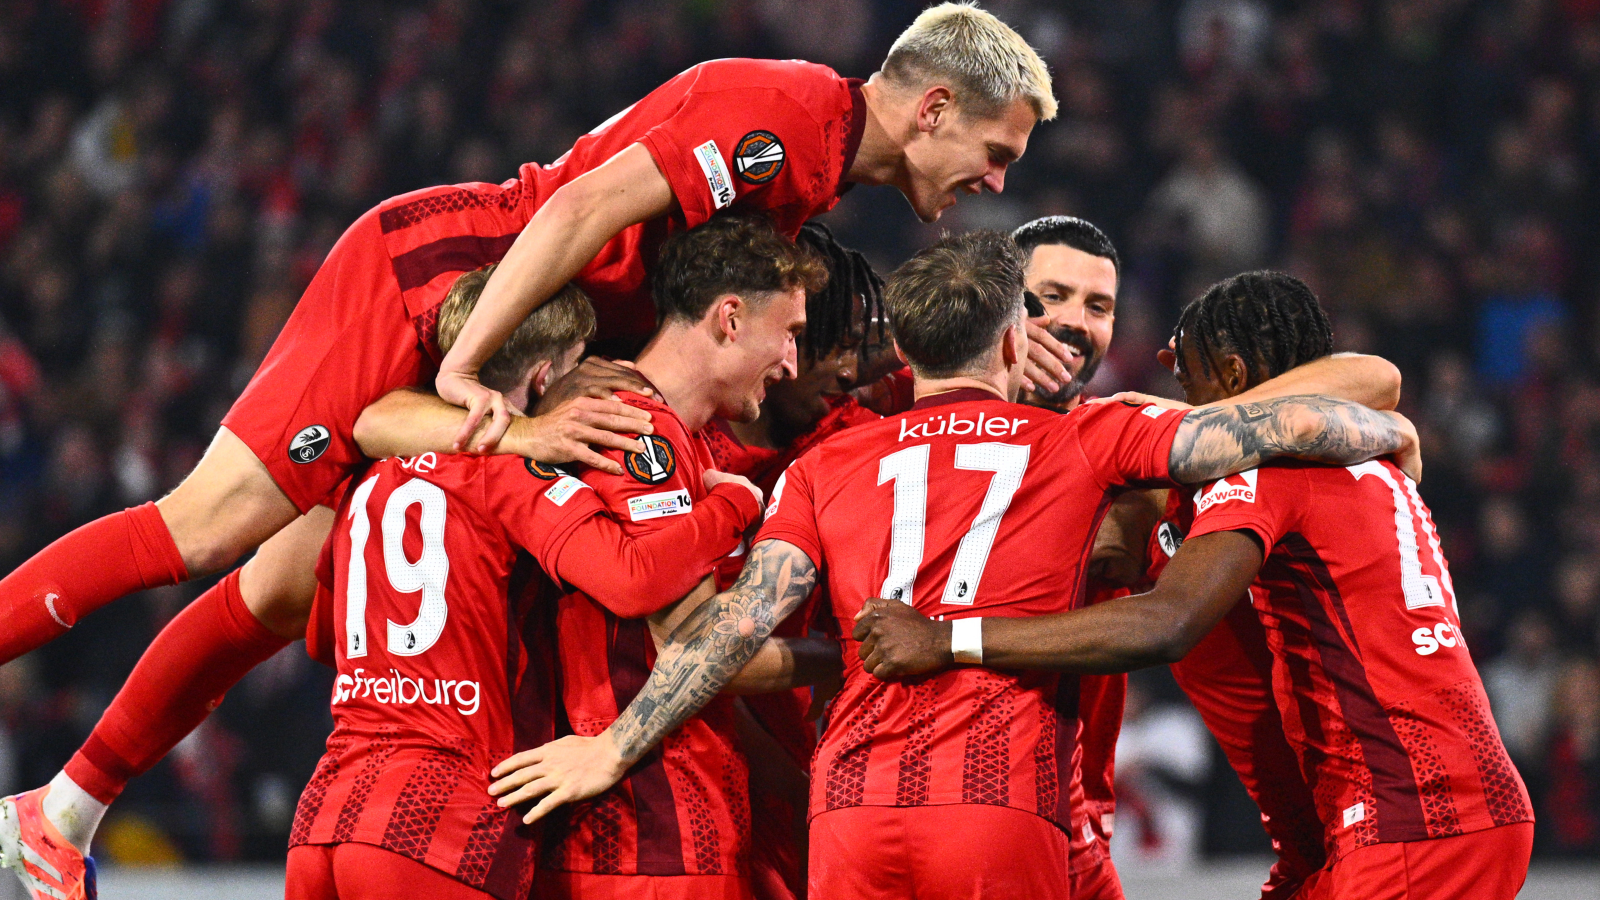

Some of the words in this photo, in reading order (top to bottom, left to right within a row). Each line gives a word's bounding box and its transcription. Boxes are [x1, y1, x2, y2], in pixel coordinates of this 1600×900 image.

[702, 145, 725, 190] FOUNDATION
[898, 412, 1029, 442] kübler
[631, 500, 677, 512] FOUNDATION
[877, 442, 1031, 605] 17
[346, 473, 449, 659] 19
